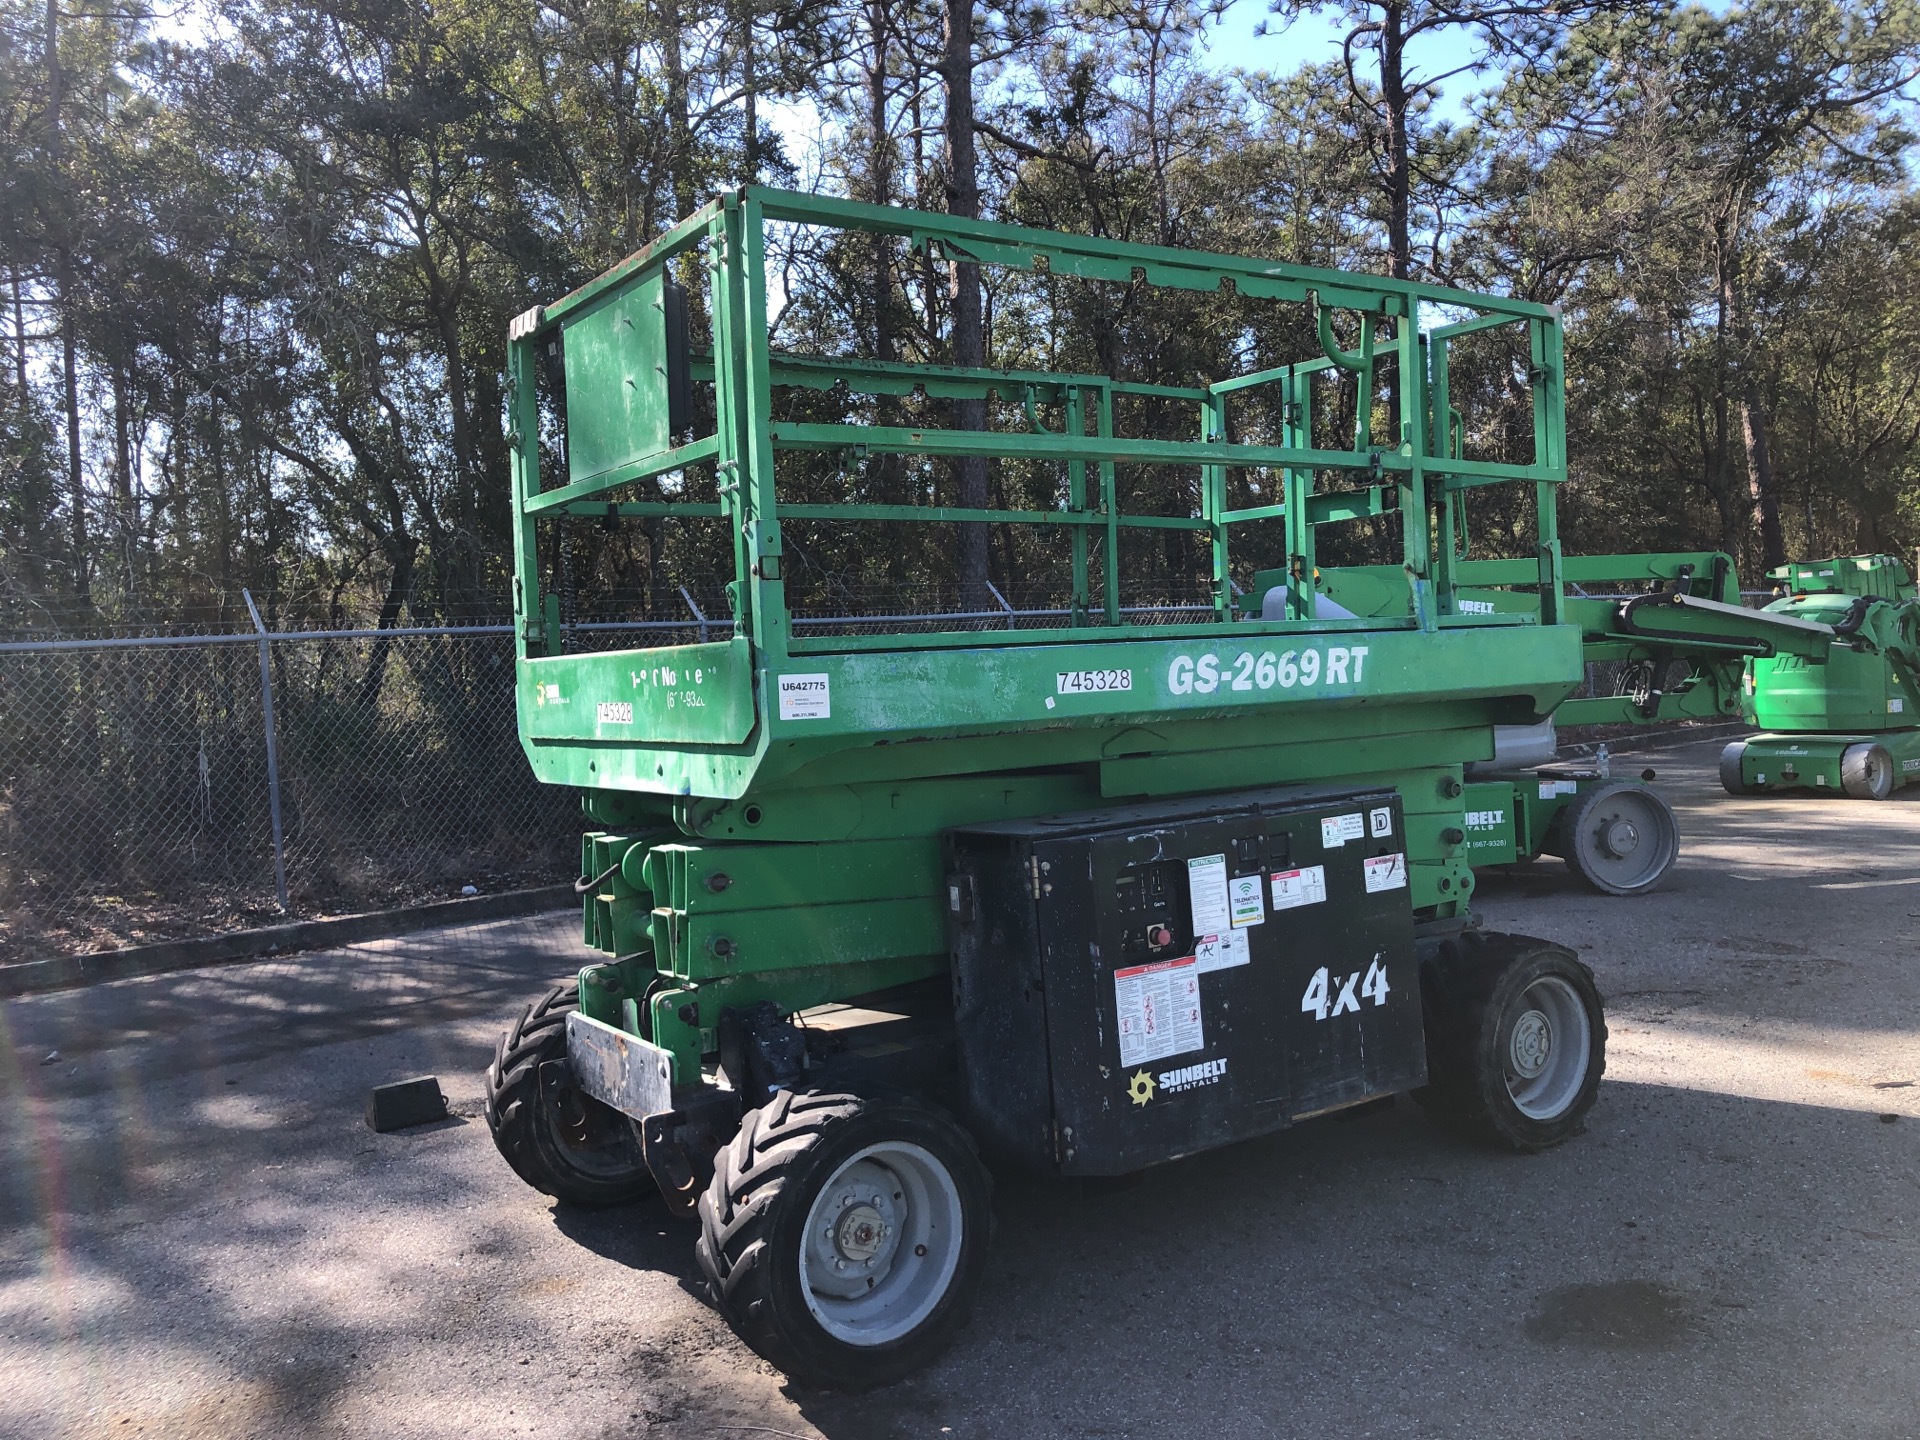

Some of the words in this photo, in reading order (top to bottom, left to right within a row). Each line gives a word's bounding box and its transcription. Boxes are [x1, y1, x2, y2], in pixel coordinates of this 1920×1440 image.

[1168, 648, 1320, 695] GS-2669
[1326, 646, 1368, 685] RT
[782, 682, 826, 691] U642775
[1059, 670, 1131, 692] 745328
[598, 703, 632, 722] 745328
[1473, 839, 1507, 849] (667-9328)
[1234, 895, 1260, 904] TELEMATICS
[1148, 962, 1172, 971] DANGER
[1159, 1058, 1228, 1090] SUNBELT
[1169, 1076, 1220, 1094] RENTALS
